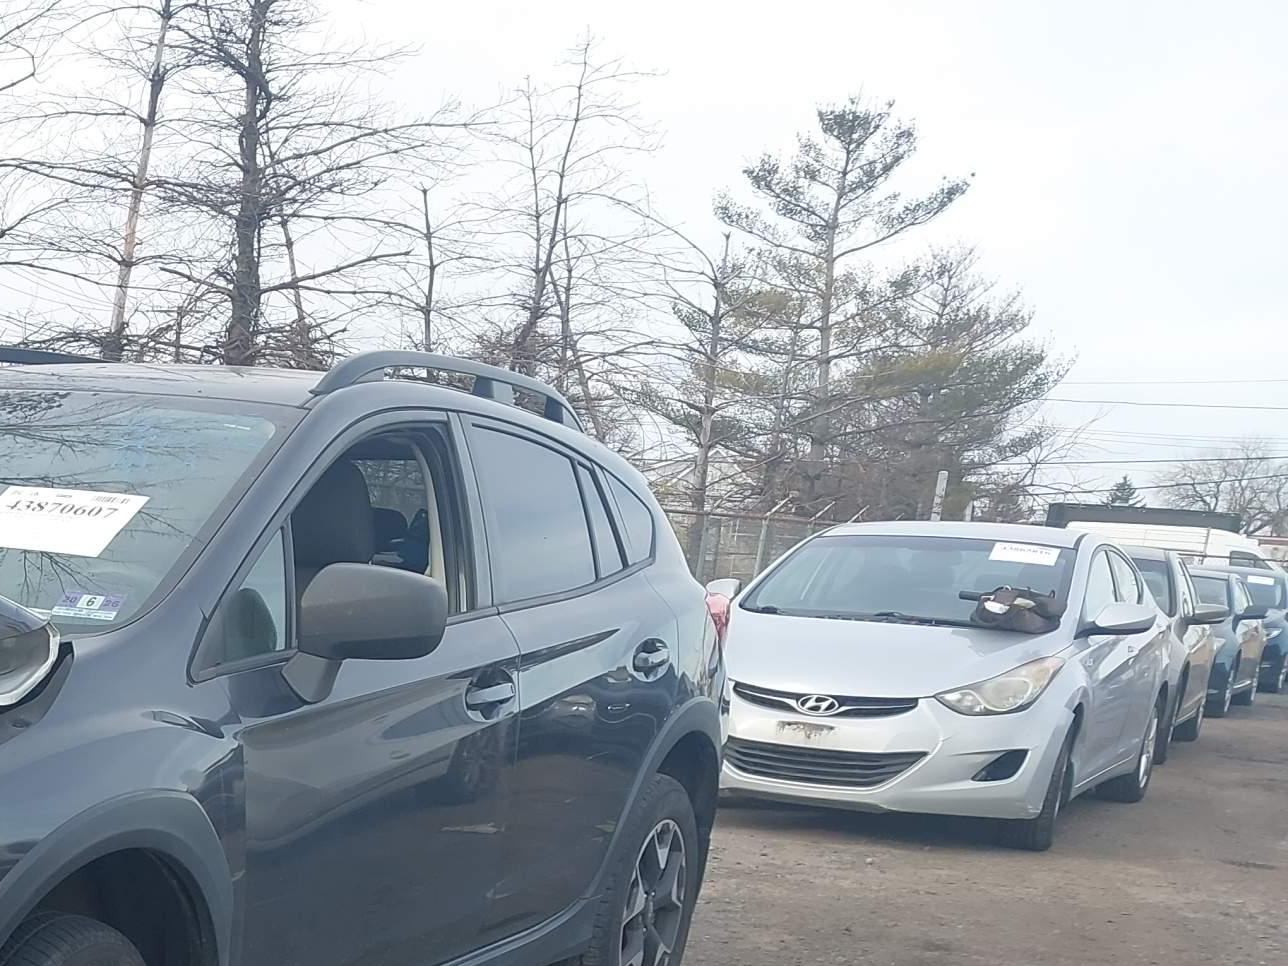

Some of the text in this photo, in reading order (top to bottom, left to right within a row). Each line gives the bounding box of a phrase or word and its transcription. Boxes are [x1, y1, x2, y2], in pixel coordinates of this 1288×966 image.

[6, 500, 119, 518] 43870607
[86, 596, 97, 607] 6
[103, 600, 120, 608] 26
